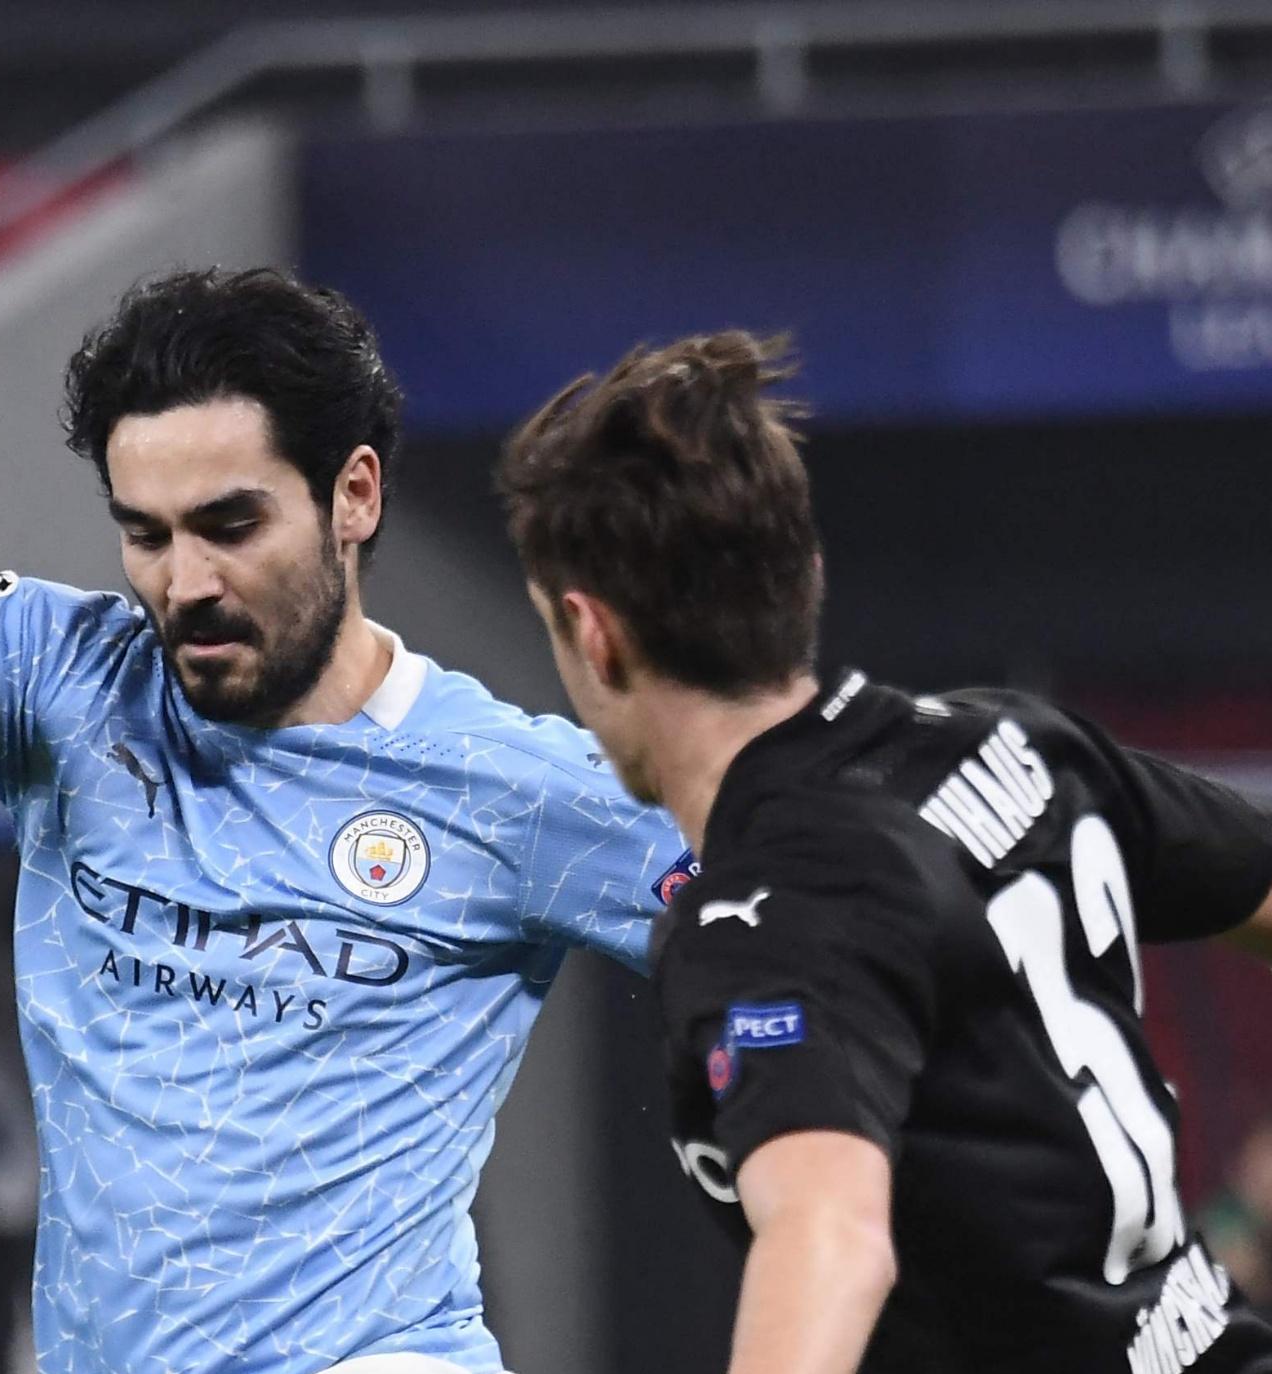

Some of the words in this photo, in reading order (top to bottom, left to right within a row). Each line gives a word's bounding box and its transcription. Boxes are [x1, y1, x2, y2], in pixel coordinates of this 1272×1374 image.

[344, 818, 421, 851] MANCHESTER
[360, 889, 390, 900] CITY
[70, 861, 410, 987] ETIHAD
[99, 949, 327, 1031] AIRWAYS
